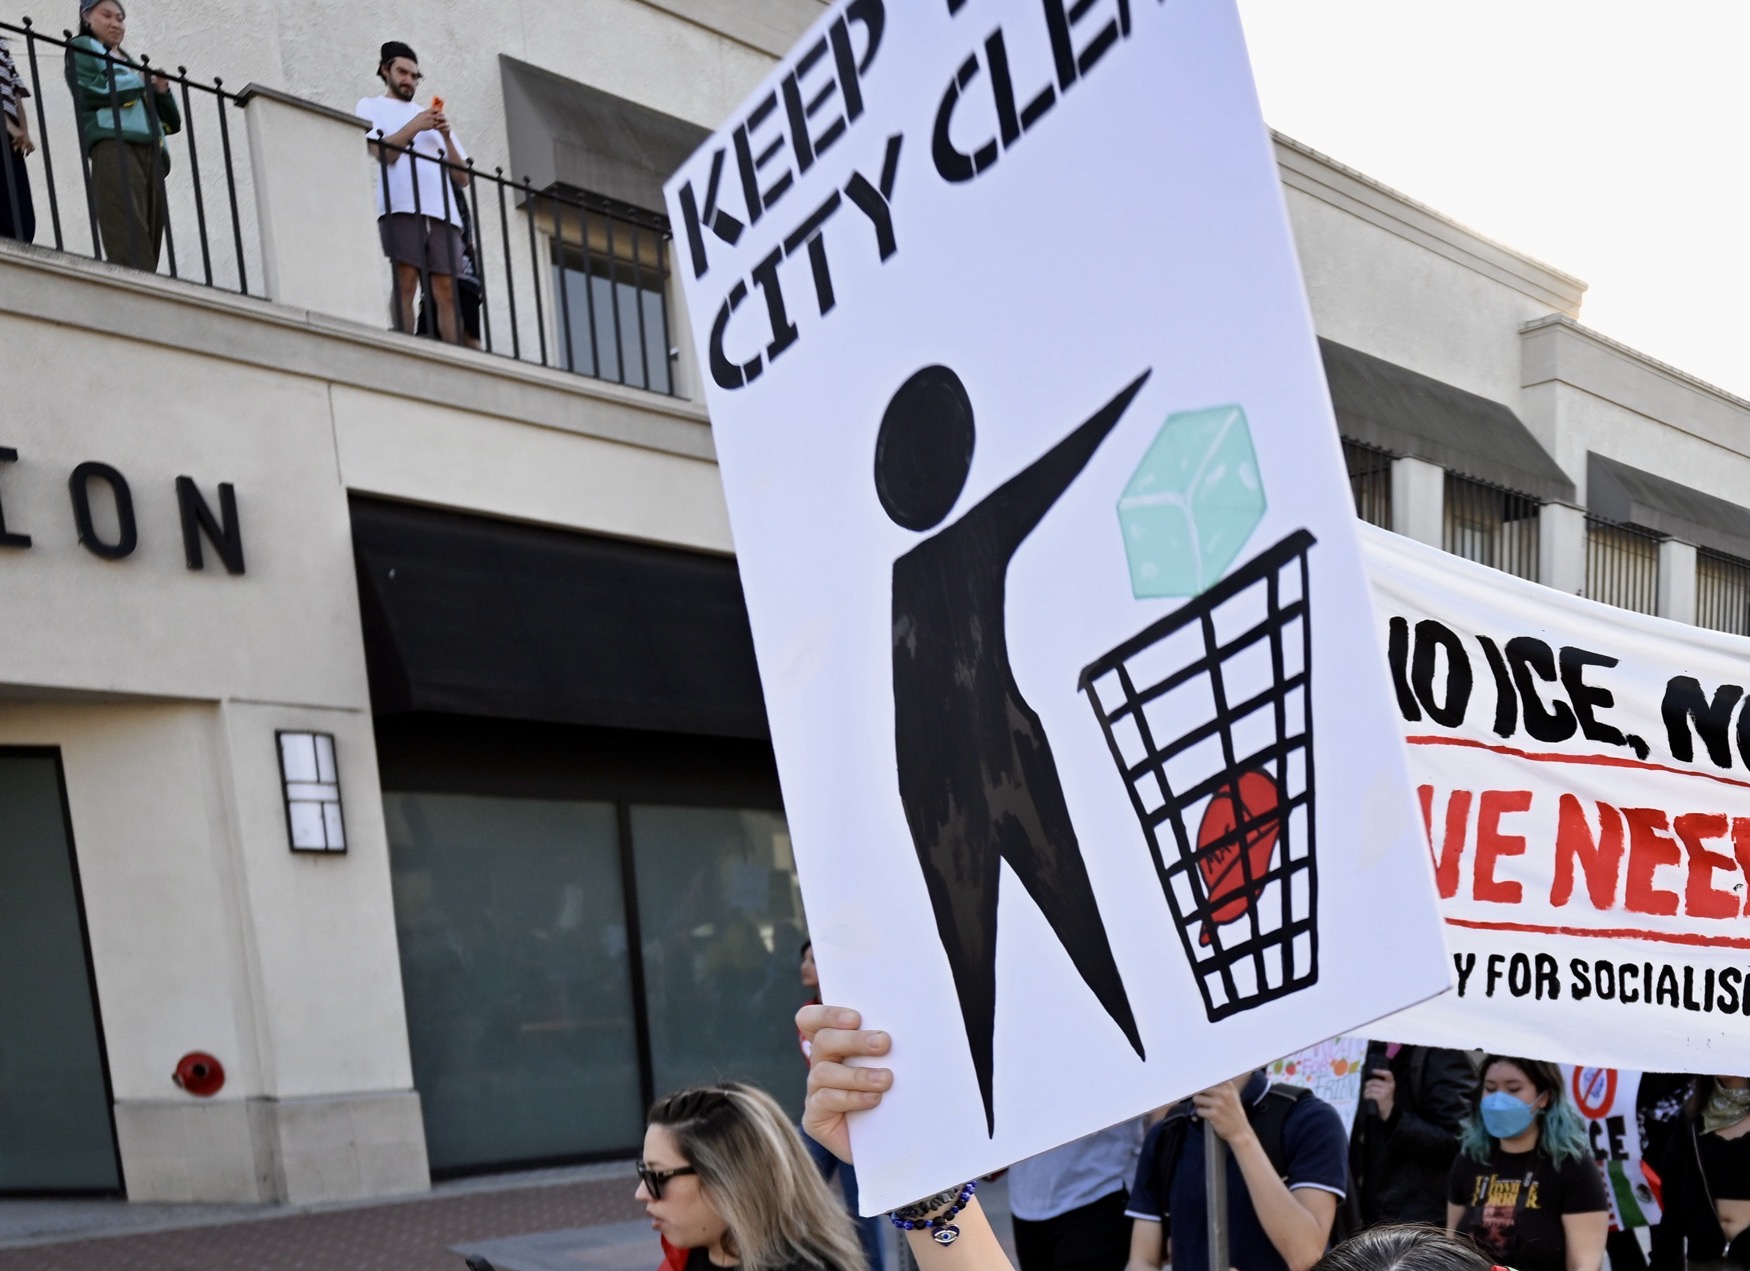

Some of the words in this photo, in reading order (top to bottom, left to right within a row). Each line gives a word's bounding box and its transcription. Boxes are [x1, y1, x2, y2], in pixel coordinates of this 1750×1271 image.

[677, 0, 886, 281] KEEP
[709, 132, 904, 391] CITY
[1475, 635, 1650, 761] ICE,
[1485, 951, 1561, 1001] FOR
